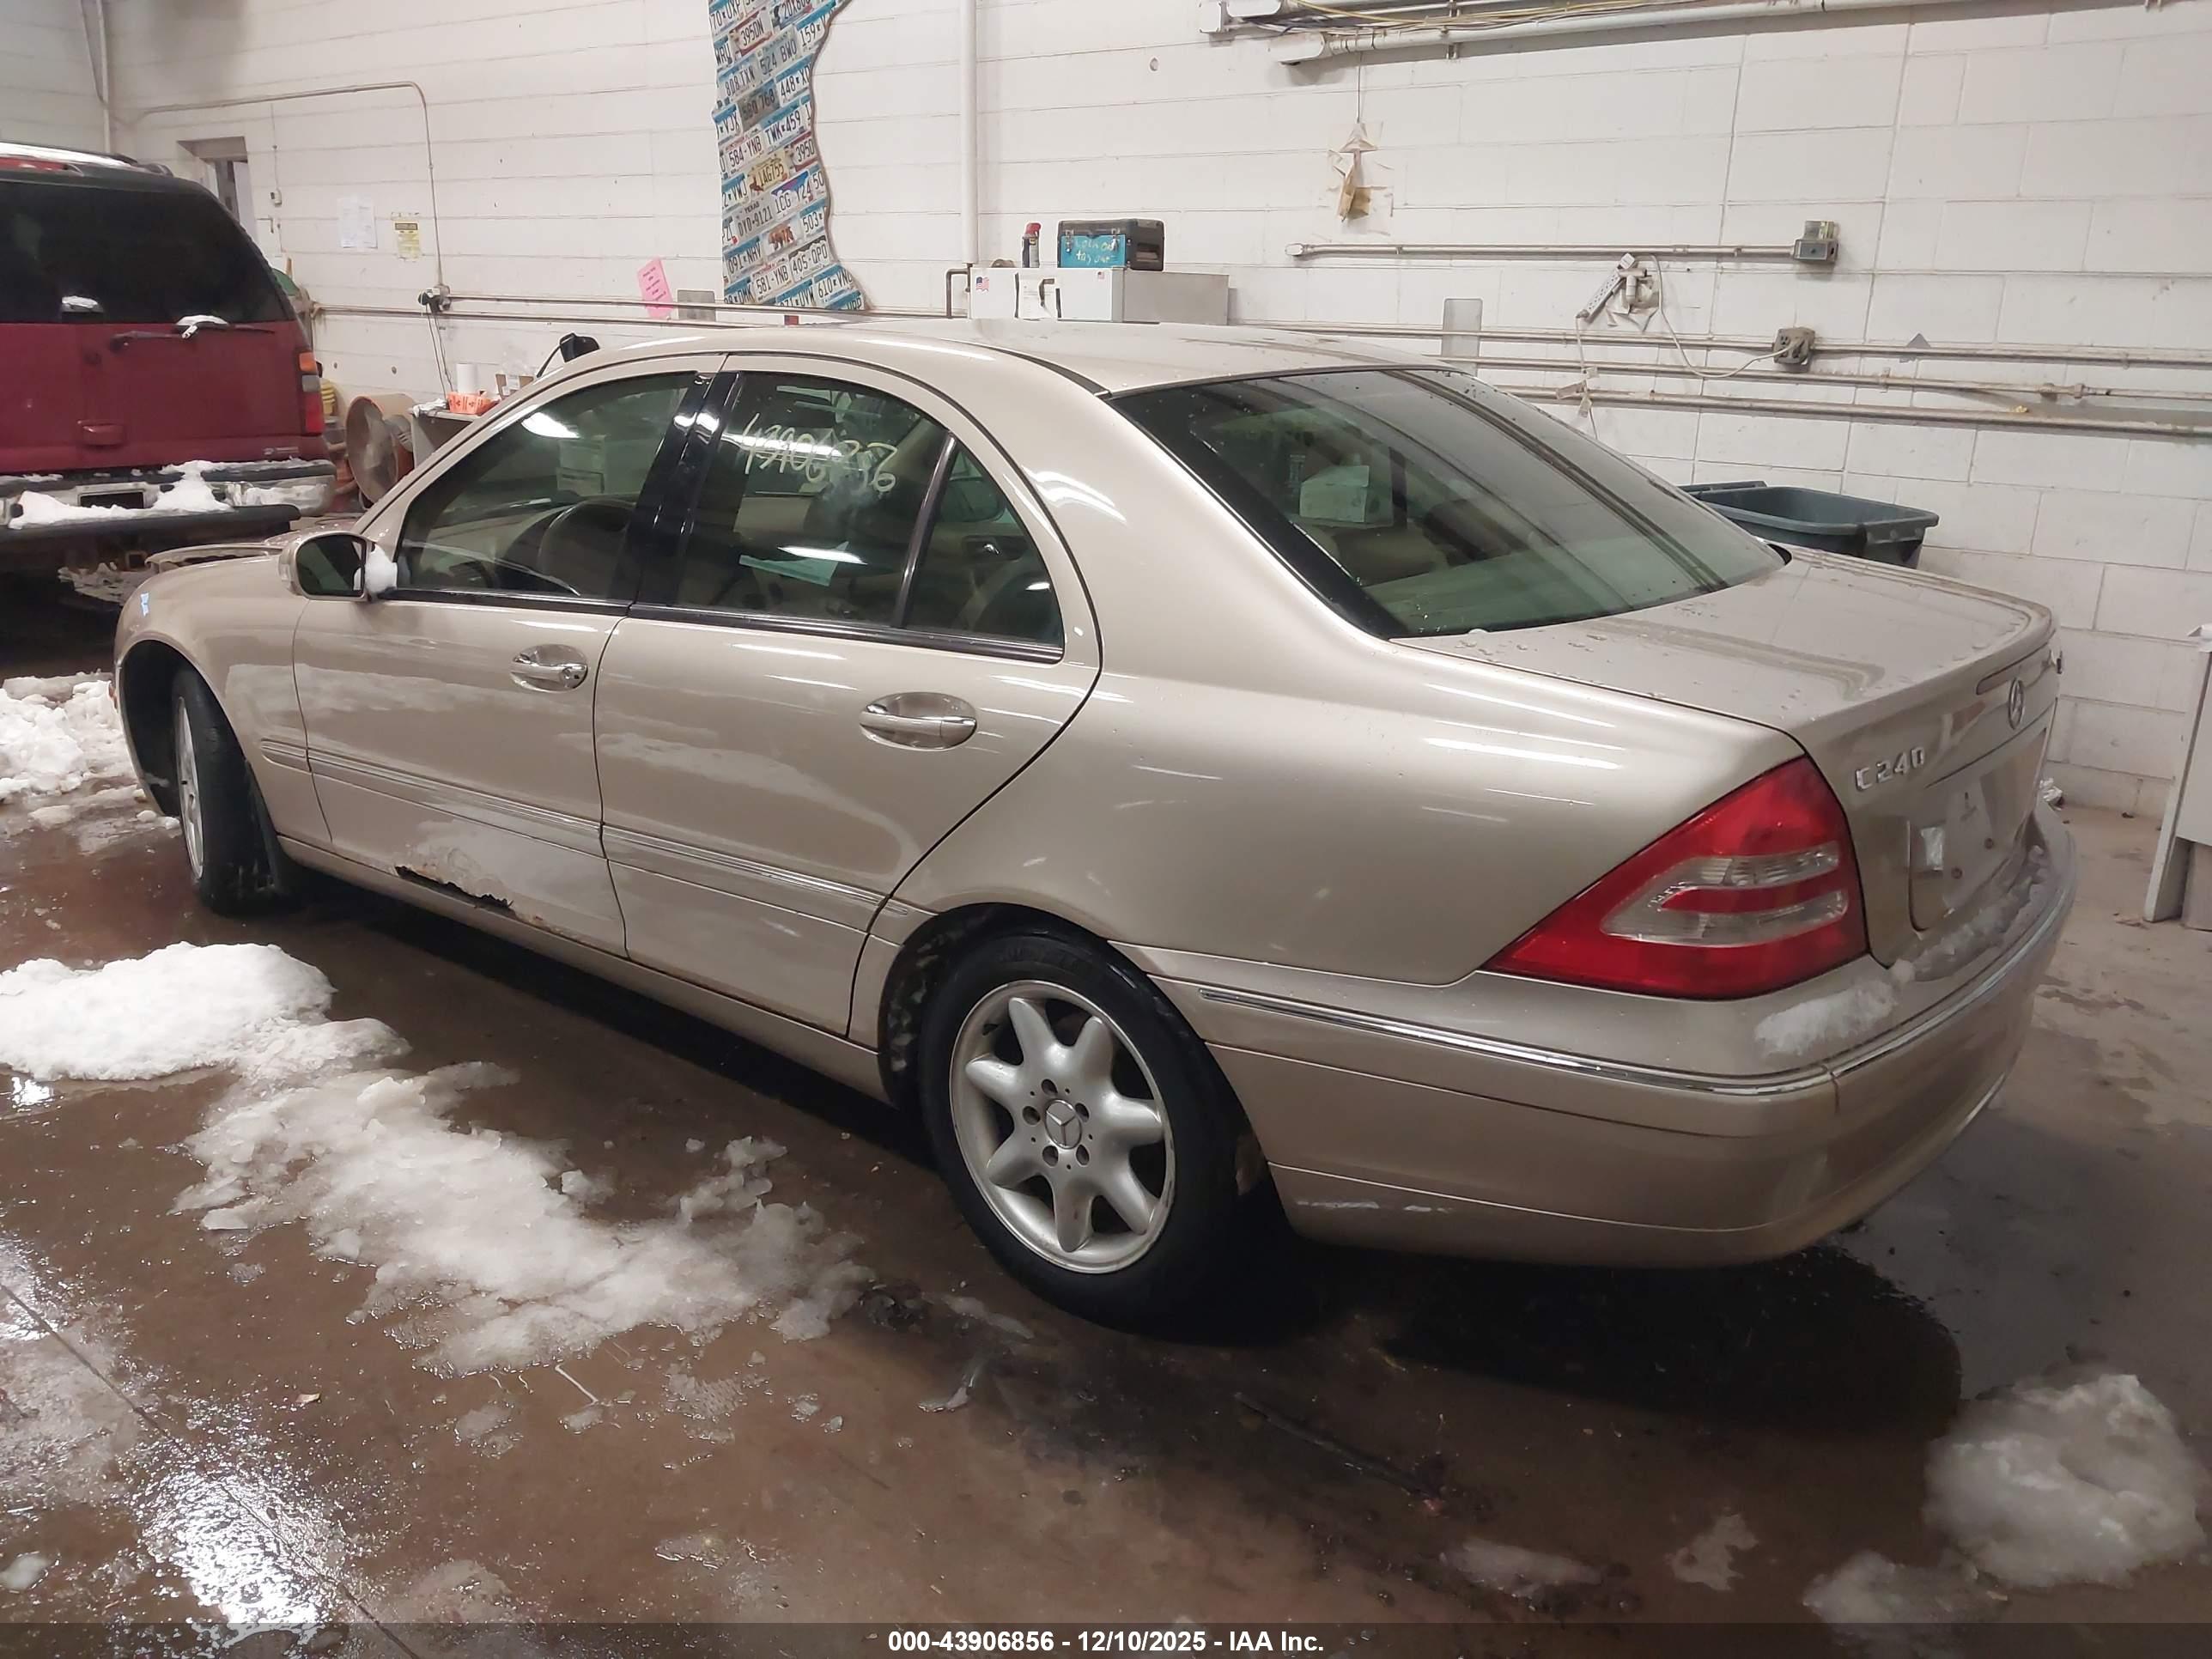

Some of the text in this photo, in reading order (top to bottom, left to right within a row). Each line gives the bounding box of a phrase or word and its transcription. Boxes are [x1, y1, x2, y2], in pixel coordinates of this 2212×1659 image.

[800, 22, 816, 46] 159
[760, 52, 777, 75] 524
[781, 76, 795, 97] 448
[765, 110, 800, 144] TWK 459
[744, 201, 760, 213] TEXAS
[803, 212, 819, 234] 503
[818, 277, 833, 298] 610
